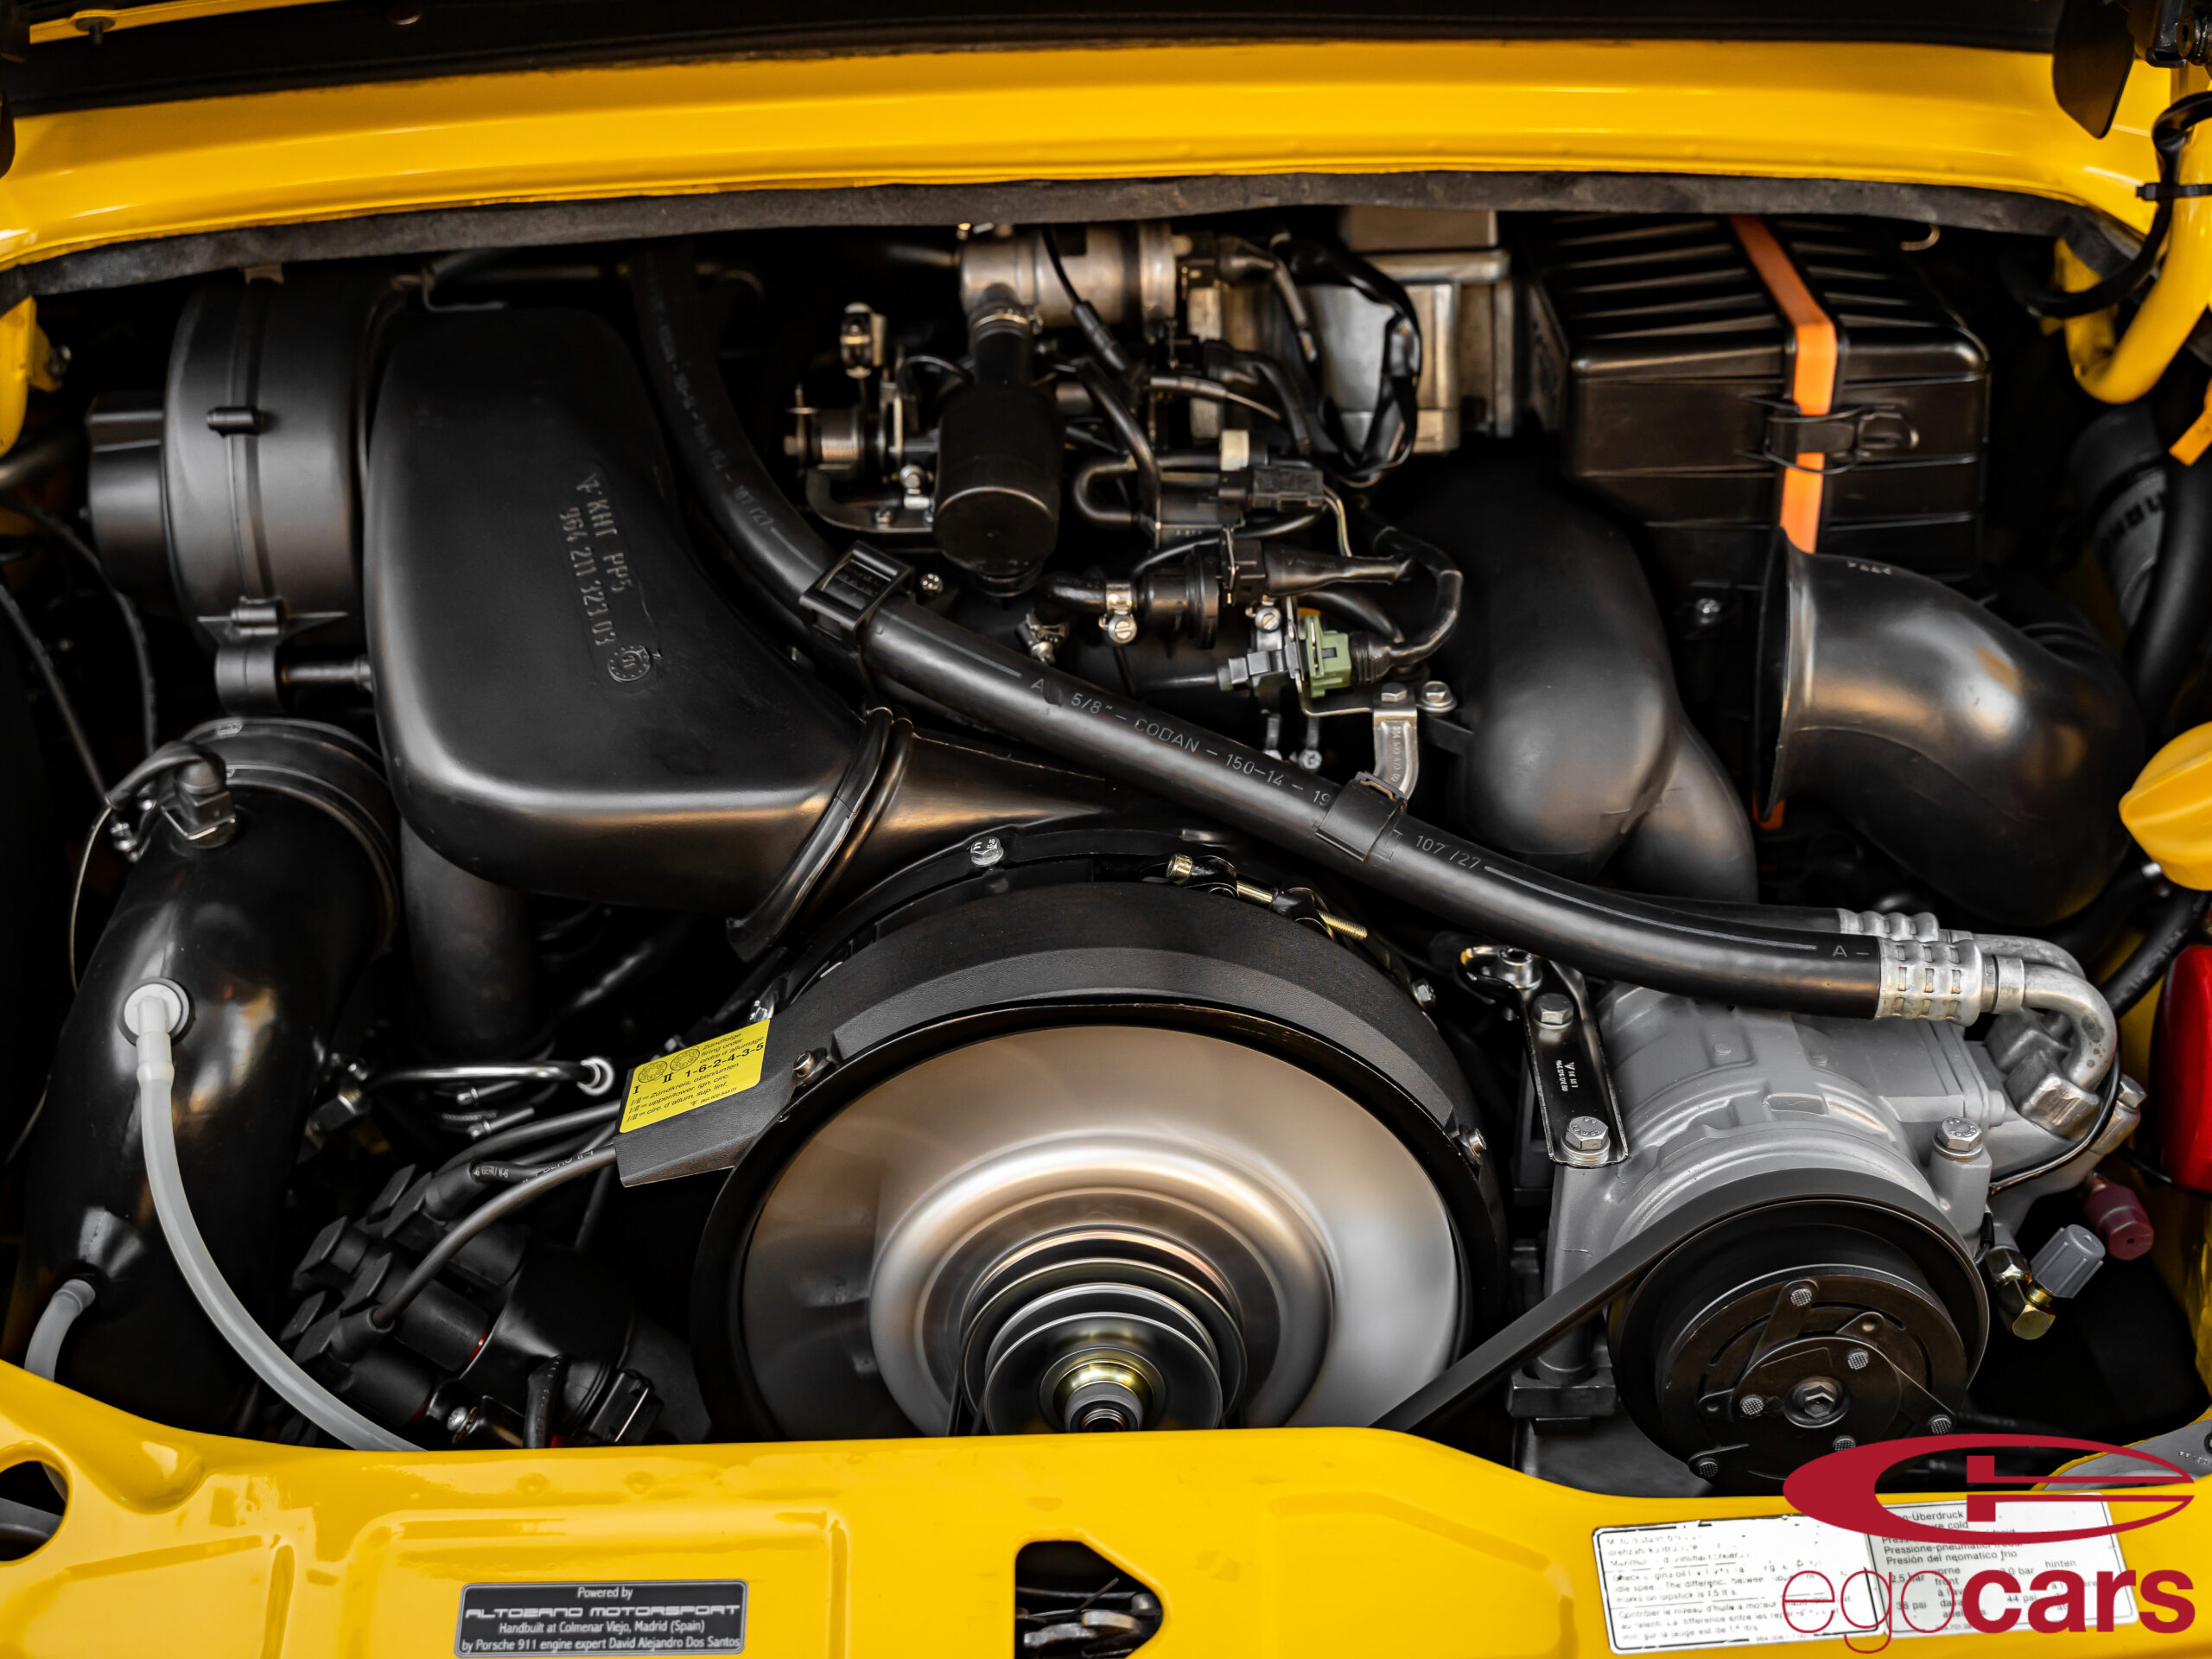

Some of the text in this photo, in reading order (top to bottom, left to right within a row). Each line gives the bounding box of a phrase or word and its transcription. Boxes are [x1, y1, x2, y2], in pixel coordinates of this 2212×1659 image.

[560, 506, 617, 646] 964 211 323 03
[1134, 718, 1201, 753] CODAN
[1225, 753, 1287, 787] 150-14
[1415, 835, 1446, 855] 107
[722, 1039, 743, 1049] order
[684, 1042, 765, 1077] 1-6-2-4-3-5
[699, 1053, 721, 1064] ordre
[1948, 1521, 1969, 1529] cold
[1926, 1553, 1942, 1562] del
[2044, 1559, 2077, 1569] hinten
[2018, 1566, 2035, 1575] bar
[577, 1586, 634, 1600] Powered by
[1912, 1599, 1927, 1611] psi
[465, 1605, 741, 1619] ALTOZANO MOTORSPORT
[499, 1618, 705, 1635] Handbuilt at Colmenar Viejo, Madrid (Spain)
[461, 1635, 741, 1654] by Porsche 911 engine expert David Alejandro Dos Santos
